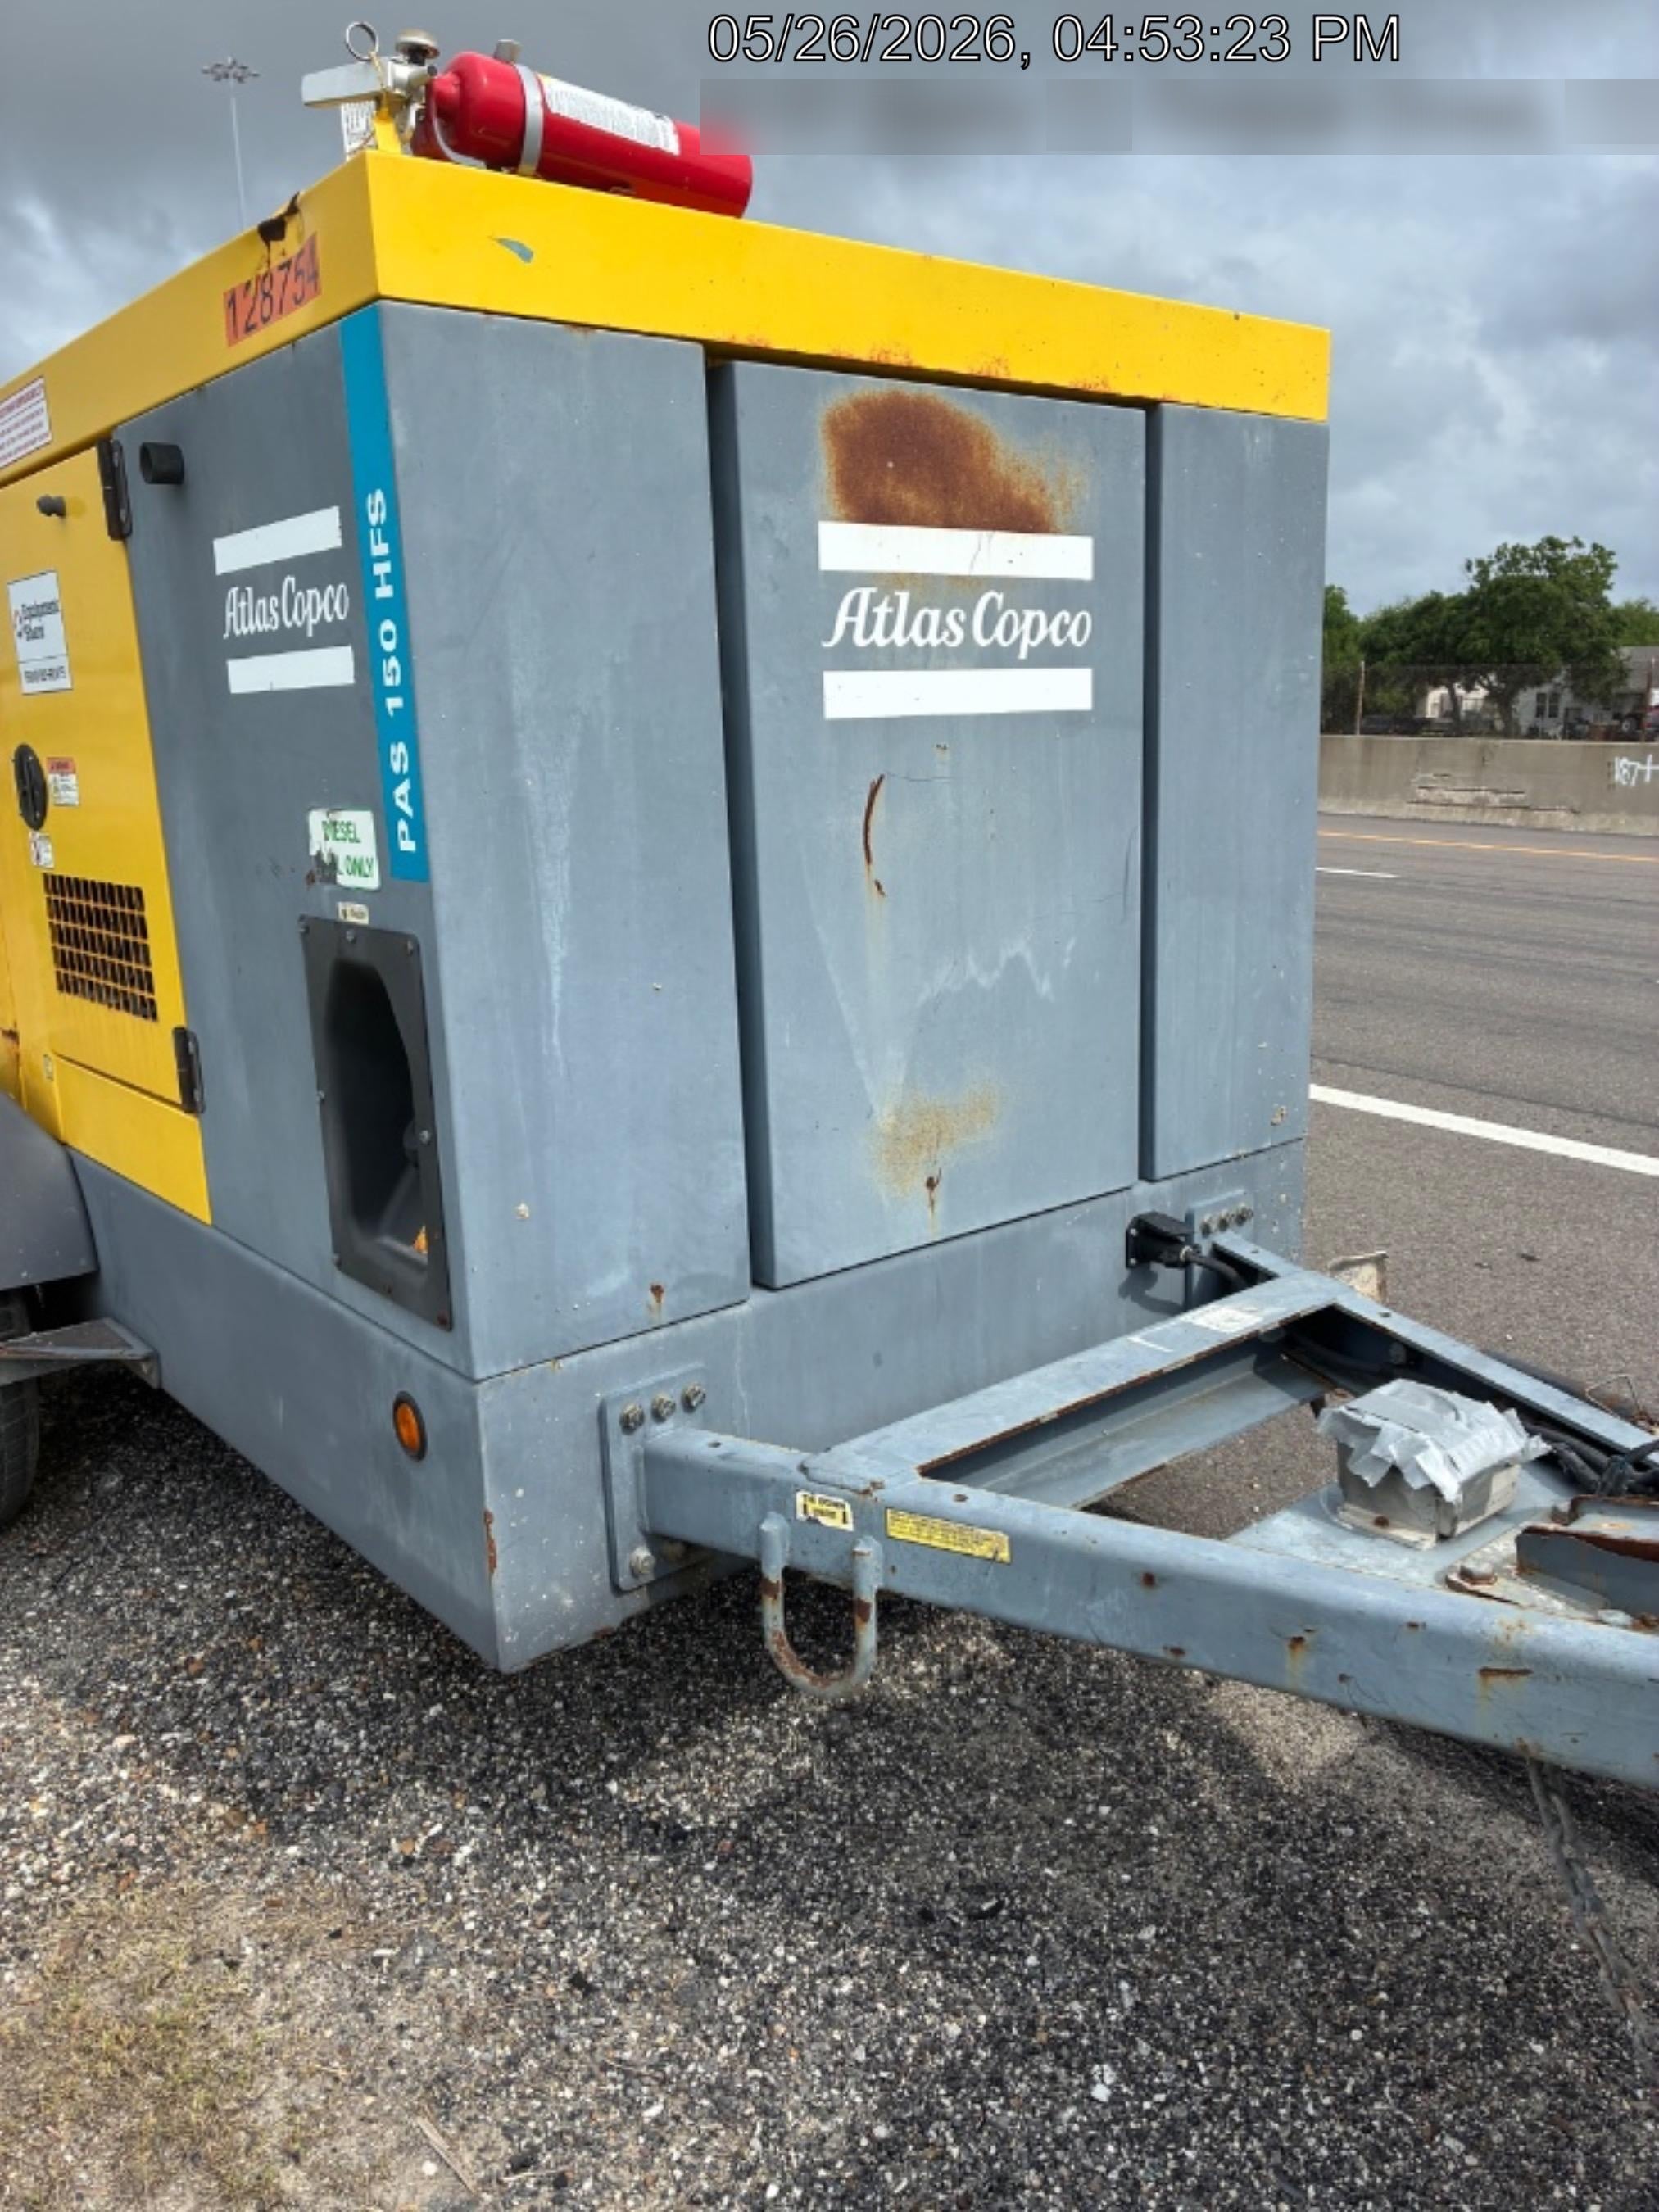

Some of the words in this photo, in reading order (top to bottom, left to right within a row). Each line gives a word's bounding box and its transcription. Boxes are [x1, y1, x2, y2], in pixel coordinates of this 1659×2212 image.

[366, 488, 395, 601] HFS
[223, 586, 279, 640] Atlas
[281, 574, 350, 638] Copco
[821, 586, 968, 648] Atlas
[972, 589, 1093, 660] Copco
[378, 619, 405, 718] 150
[389, 741, 417, 853] PAS
[345, 854, 374, 878] ONLY
